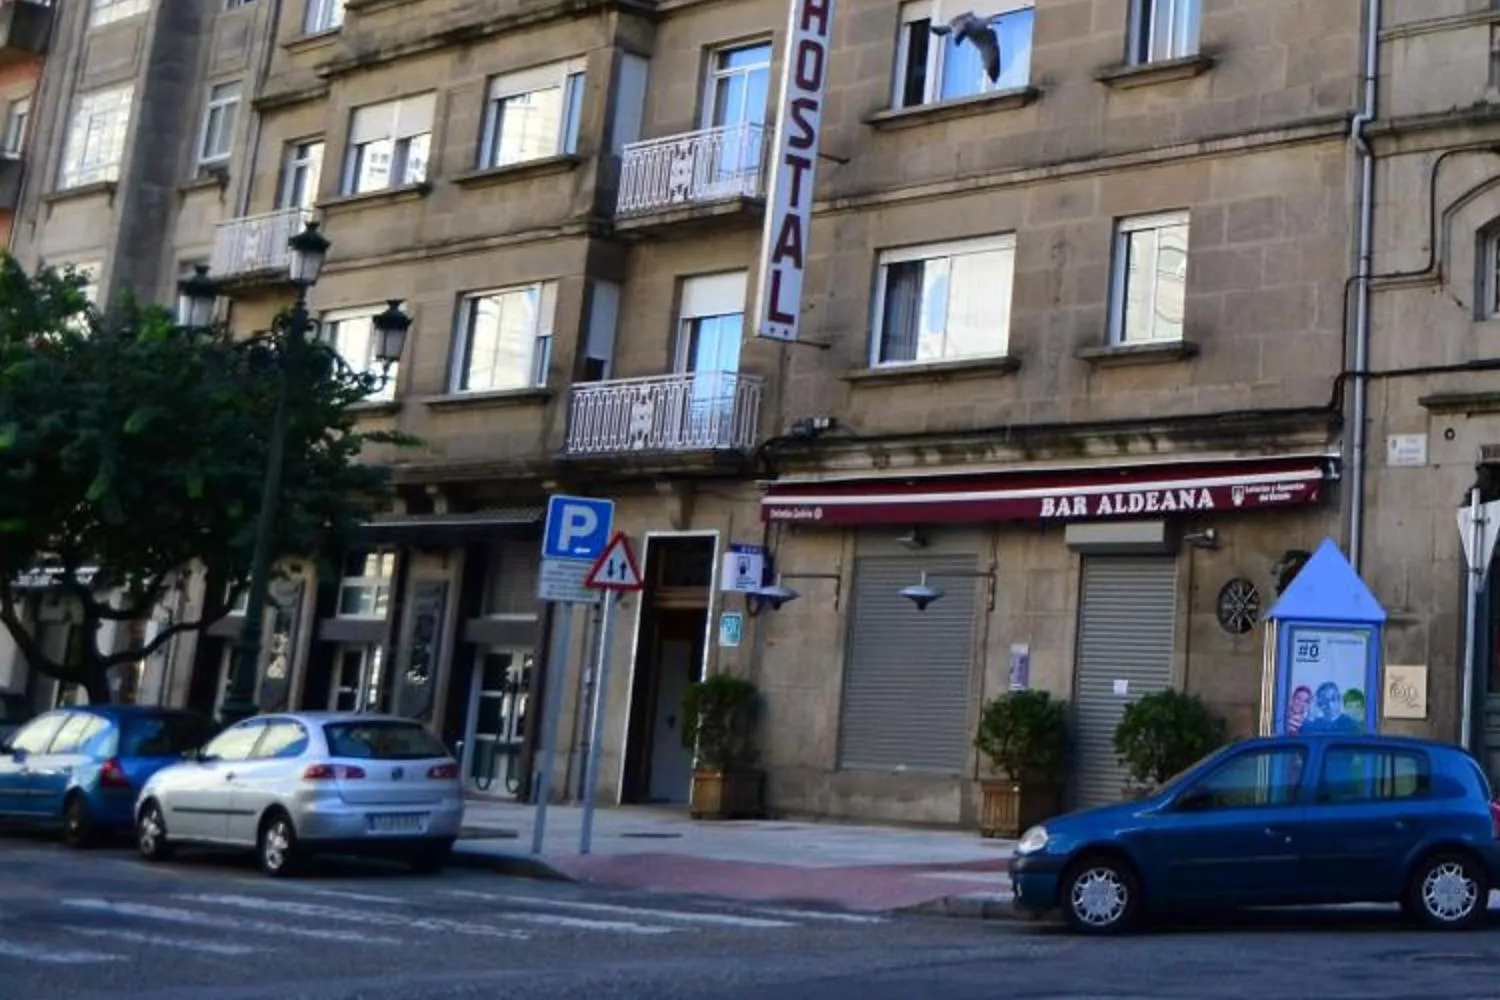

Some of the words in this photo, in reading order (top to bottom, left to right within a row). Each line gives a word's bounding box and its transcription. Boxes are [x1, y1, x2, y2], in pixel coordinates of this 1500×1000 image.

[1039, 495, 1087, 517] BAR
[1096, 487, 1215, 515] ALDEANA
[557, 504, 599, 552] P
